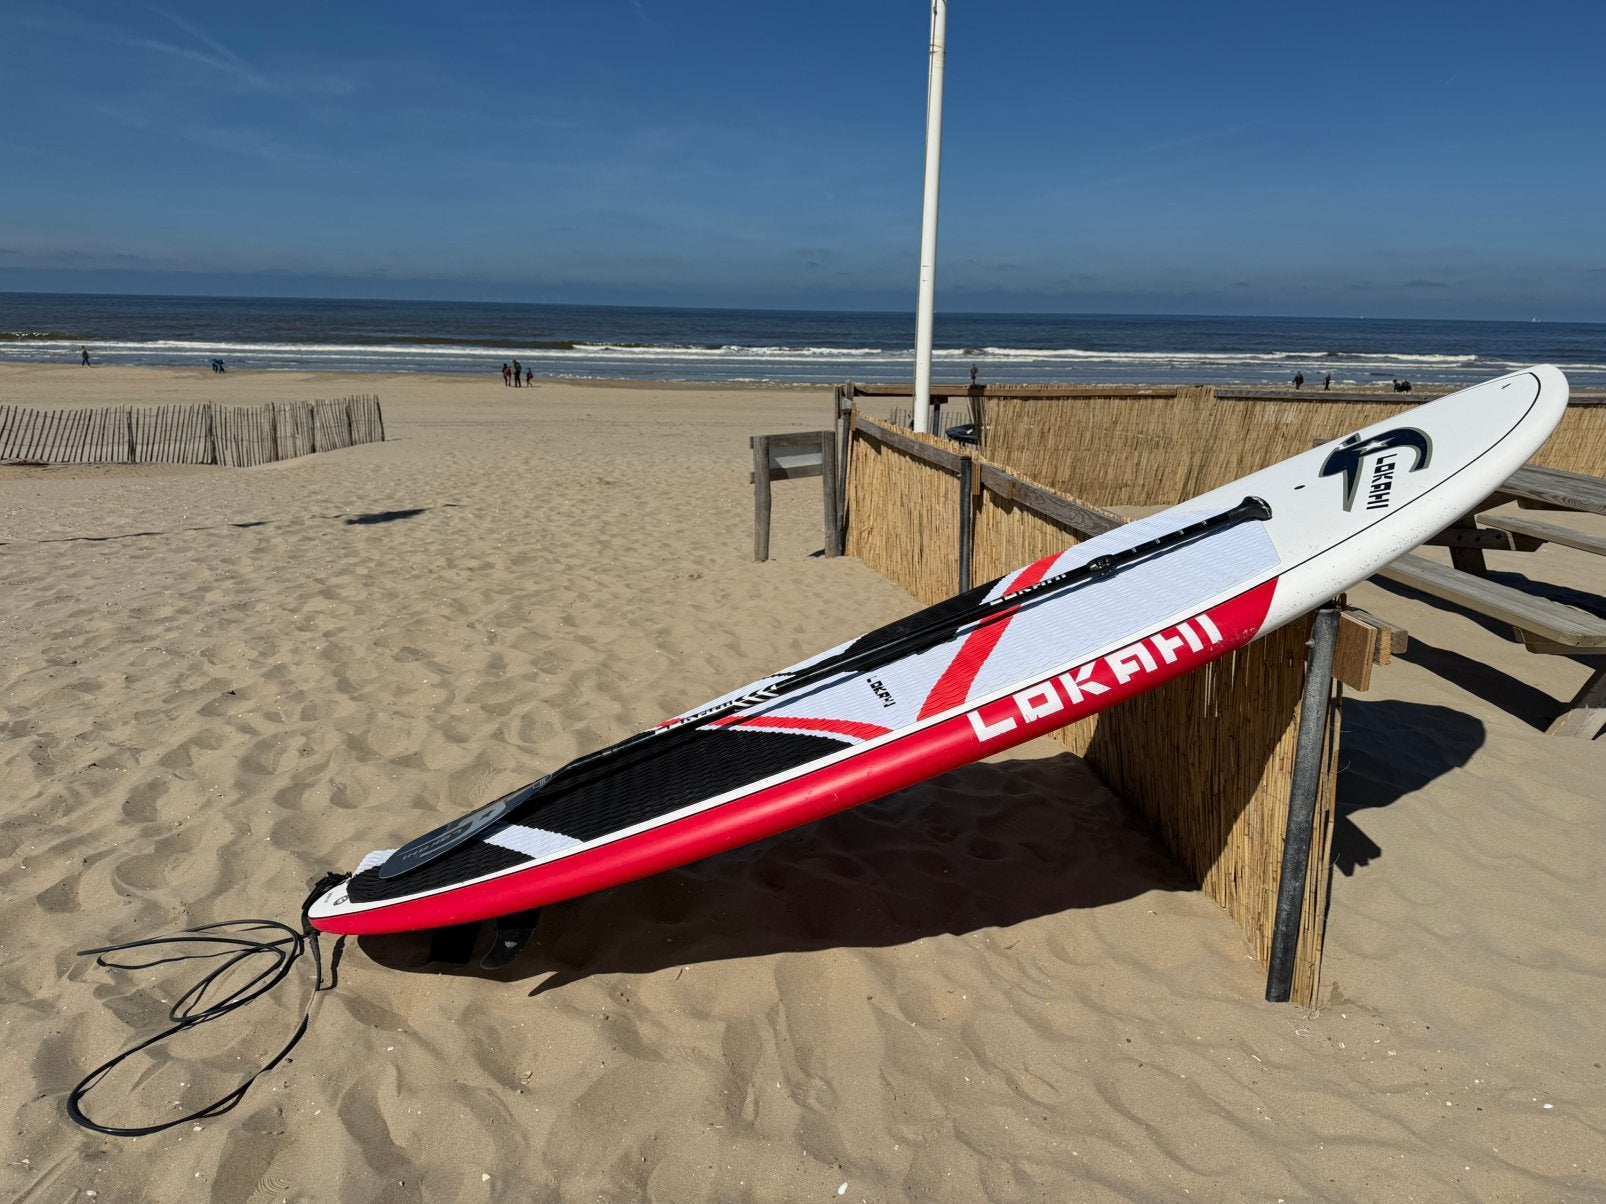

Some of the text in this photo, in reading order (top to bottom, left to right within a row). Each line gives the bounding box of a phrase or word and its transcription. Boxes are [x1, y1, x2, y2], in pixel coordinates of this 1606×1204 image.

[1366, 453, 1398, 510] LOKAHI
[866, 675, 897, 709] LOKAHI
[967, 613, 1224, 742] LOKAHI
